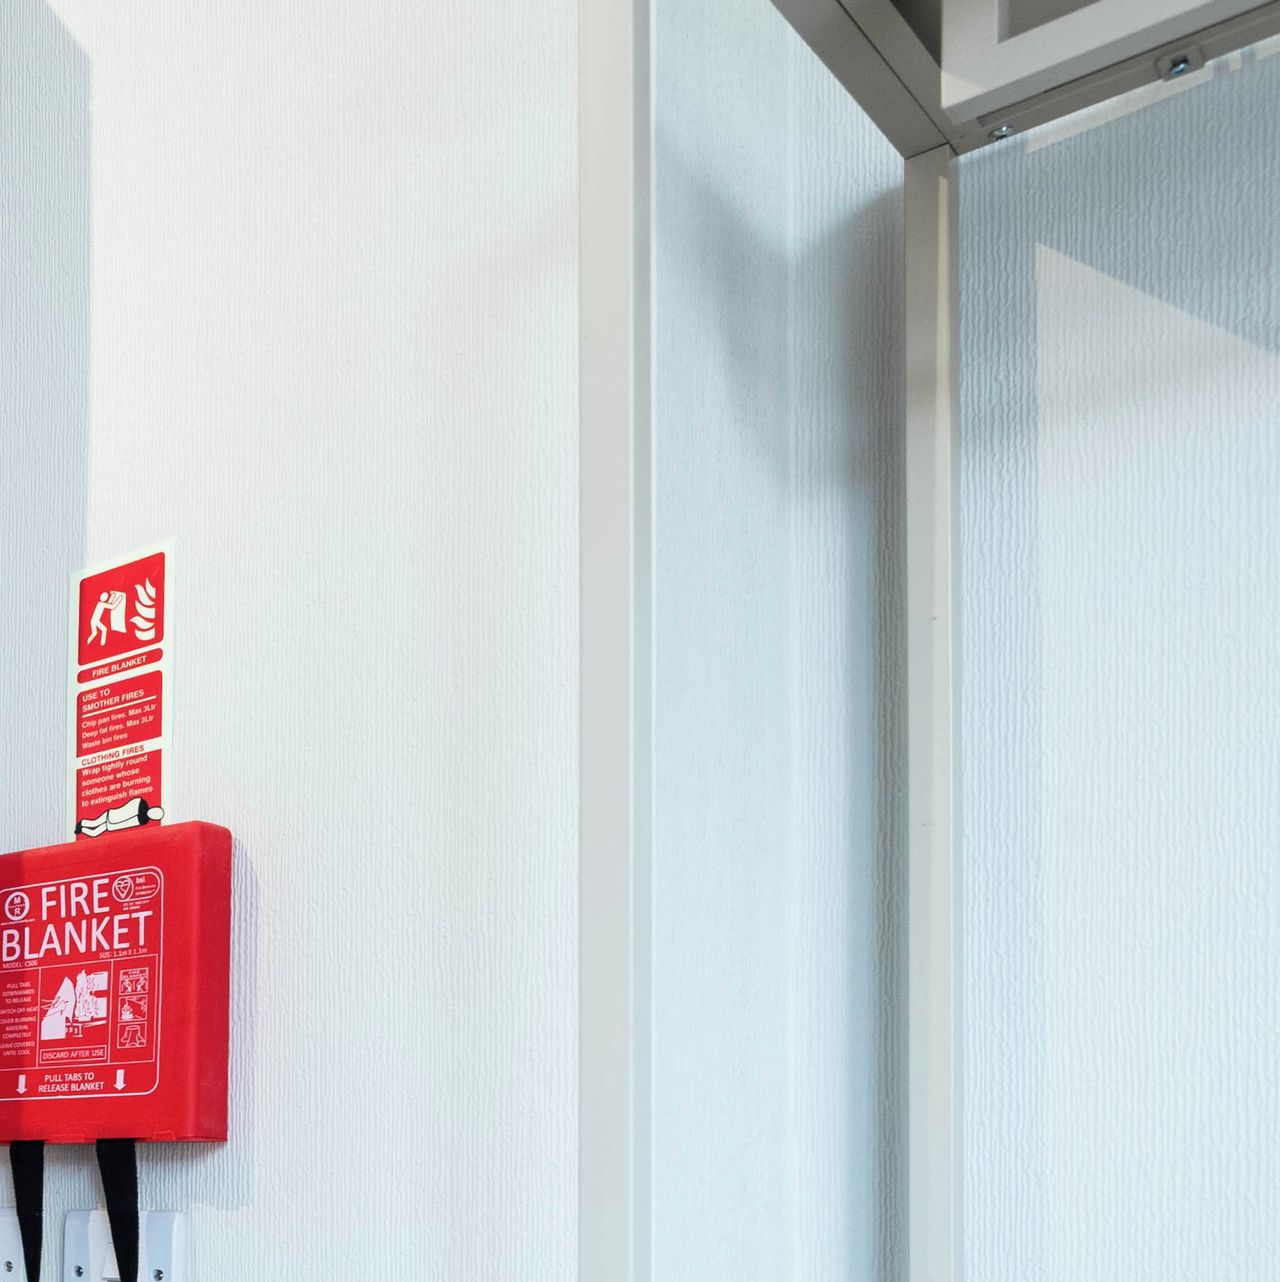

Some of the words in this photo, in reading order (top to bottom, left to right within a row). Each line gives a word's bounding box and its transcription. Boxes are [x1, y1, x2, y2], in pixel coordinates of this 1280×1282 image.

[92, 666, 110, 678] FIRE
[111, 655, 147, 672] BLANKET
[82, 691, 97, 702] USE
[100, 688, 110, 697] TO
[82, 697, 120, 712] SMOTHER
[121, 689, 144, 702] FIRES
[82, 720, 97, 729] Chip
[98, 716, 110, 725] pan
[128, 708, 142, 716] Max
[82, 729, 98, 739] Deep
[99, 726, 108, 735] fat
[126, 719, 140, 728] Max
[81, 739, 101, 750] Waste
[102, 735, 112, 744] bin
[113, 732, 128, 742] fires
[81, 750, 120, 766] CLOTHING
[122, 744, 145, 758] FIRES
[81, 766, 100, 777] Wrap
[102, 760, 125, 773] tightly
[125, 754, 148, 766] round
[81, 785, 108, 797] clothes
[109, 782, 121, 790] are
[122, 775, 151, 788] burning
[82, 774, 115, 787] someone
[116, 768, 140, 779] whose
[81, 800, 89, 808] to
[90, 791, 127, 806] extinguish
[128, 786, 153, 797] flames
[41, 878, 110, 921] FIRE
[2, 910, 153, 962] BLANKET
[42, 1051, 69, 1060] DISCARD
[70, 1050, 90, 1058] AFTER
[91, 1048, 105, 1057] USE
[38, 1083, 70, 1093] RELEASE
[70, 1081, 105, 1091] BLANKET
[44, 1074, 63, 1083] PULL
[64, 1072, 83, 1081] TABS
[83, 1072, 95, 1081] TO
